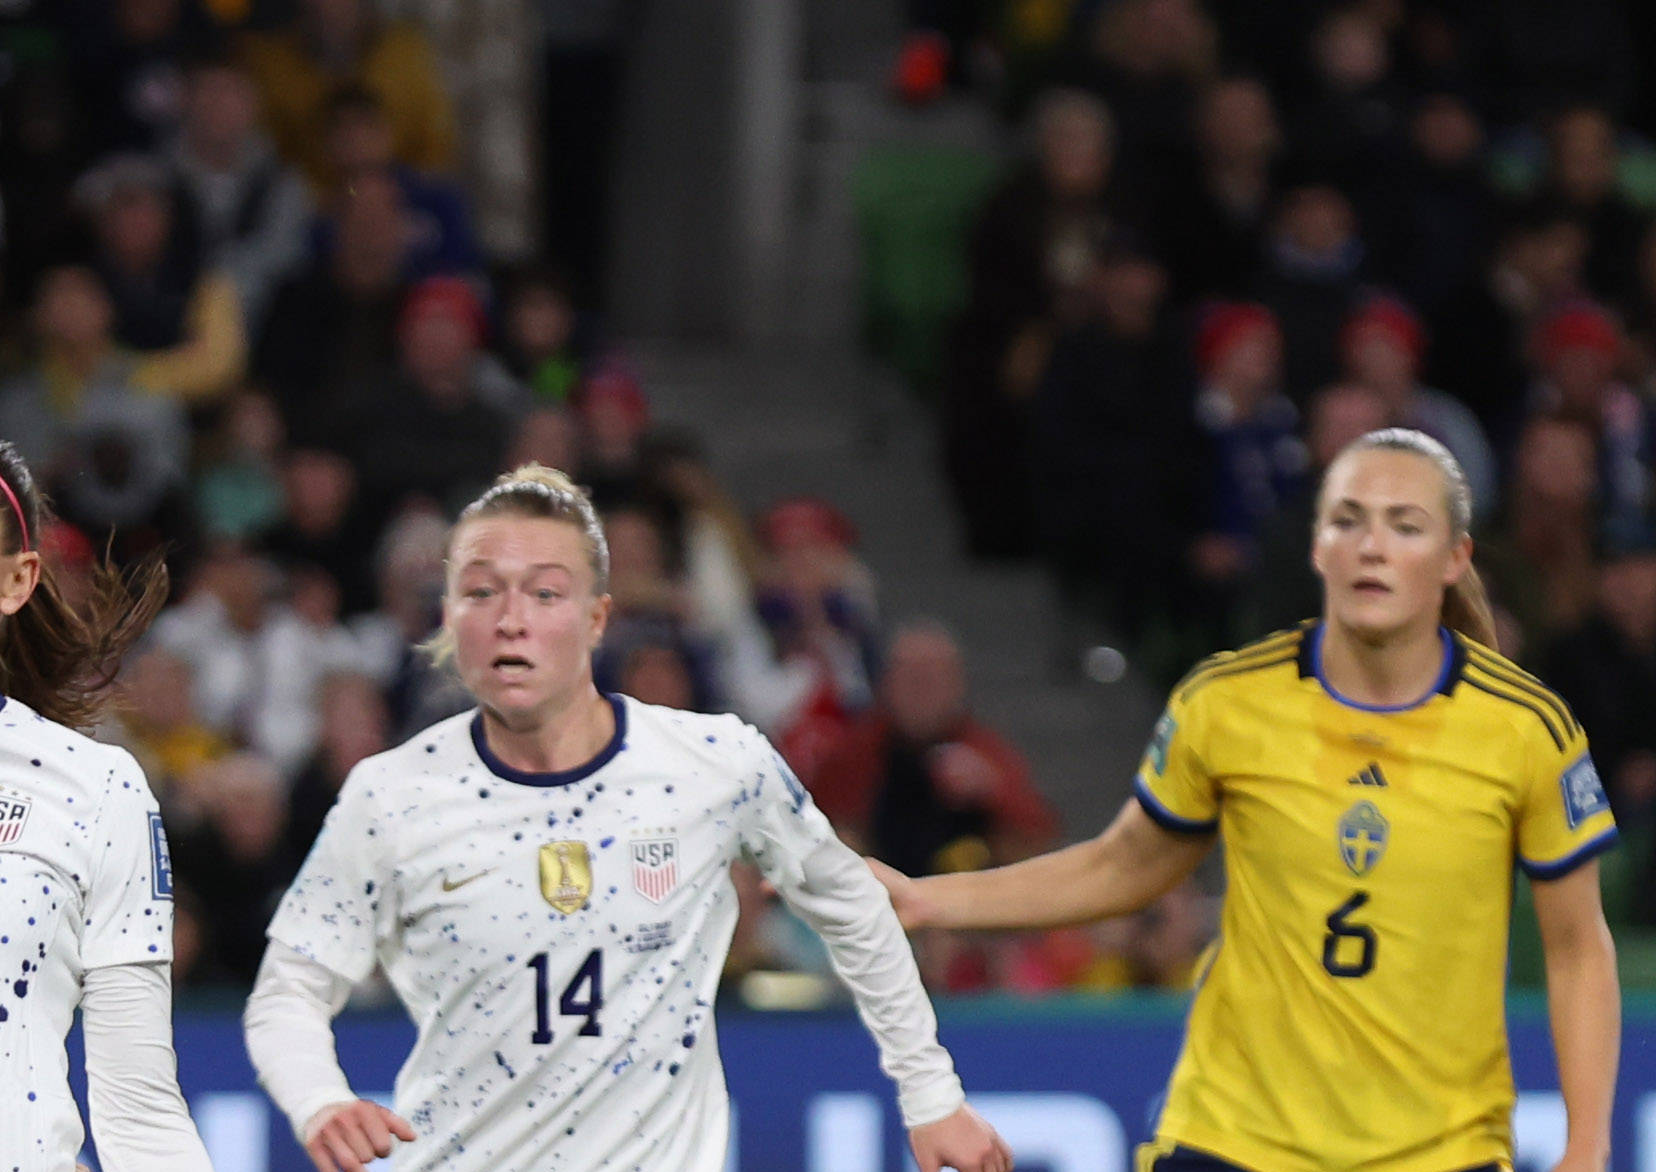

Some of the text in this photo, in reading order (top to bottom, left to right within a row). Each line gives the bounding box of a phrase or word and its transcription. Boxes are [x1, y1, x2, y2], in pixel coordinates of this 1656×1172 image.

[635, 843, 674, 867] USA
[1323, 889, 1378, 977] 6
[526, 947, 605, 1044] 14
